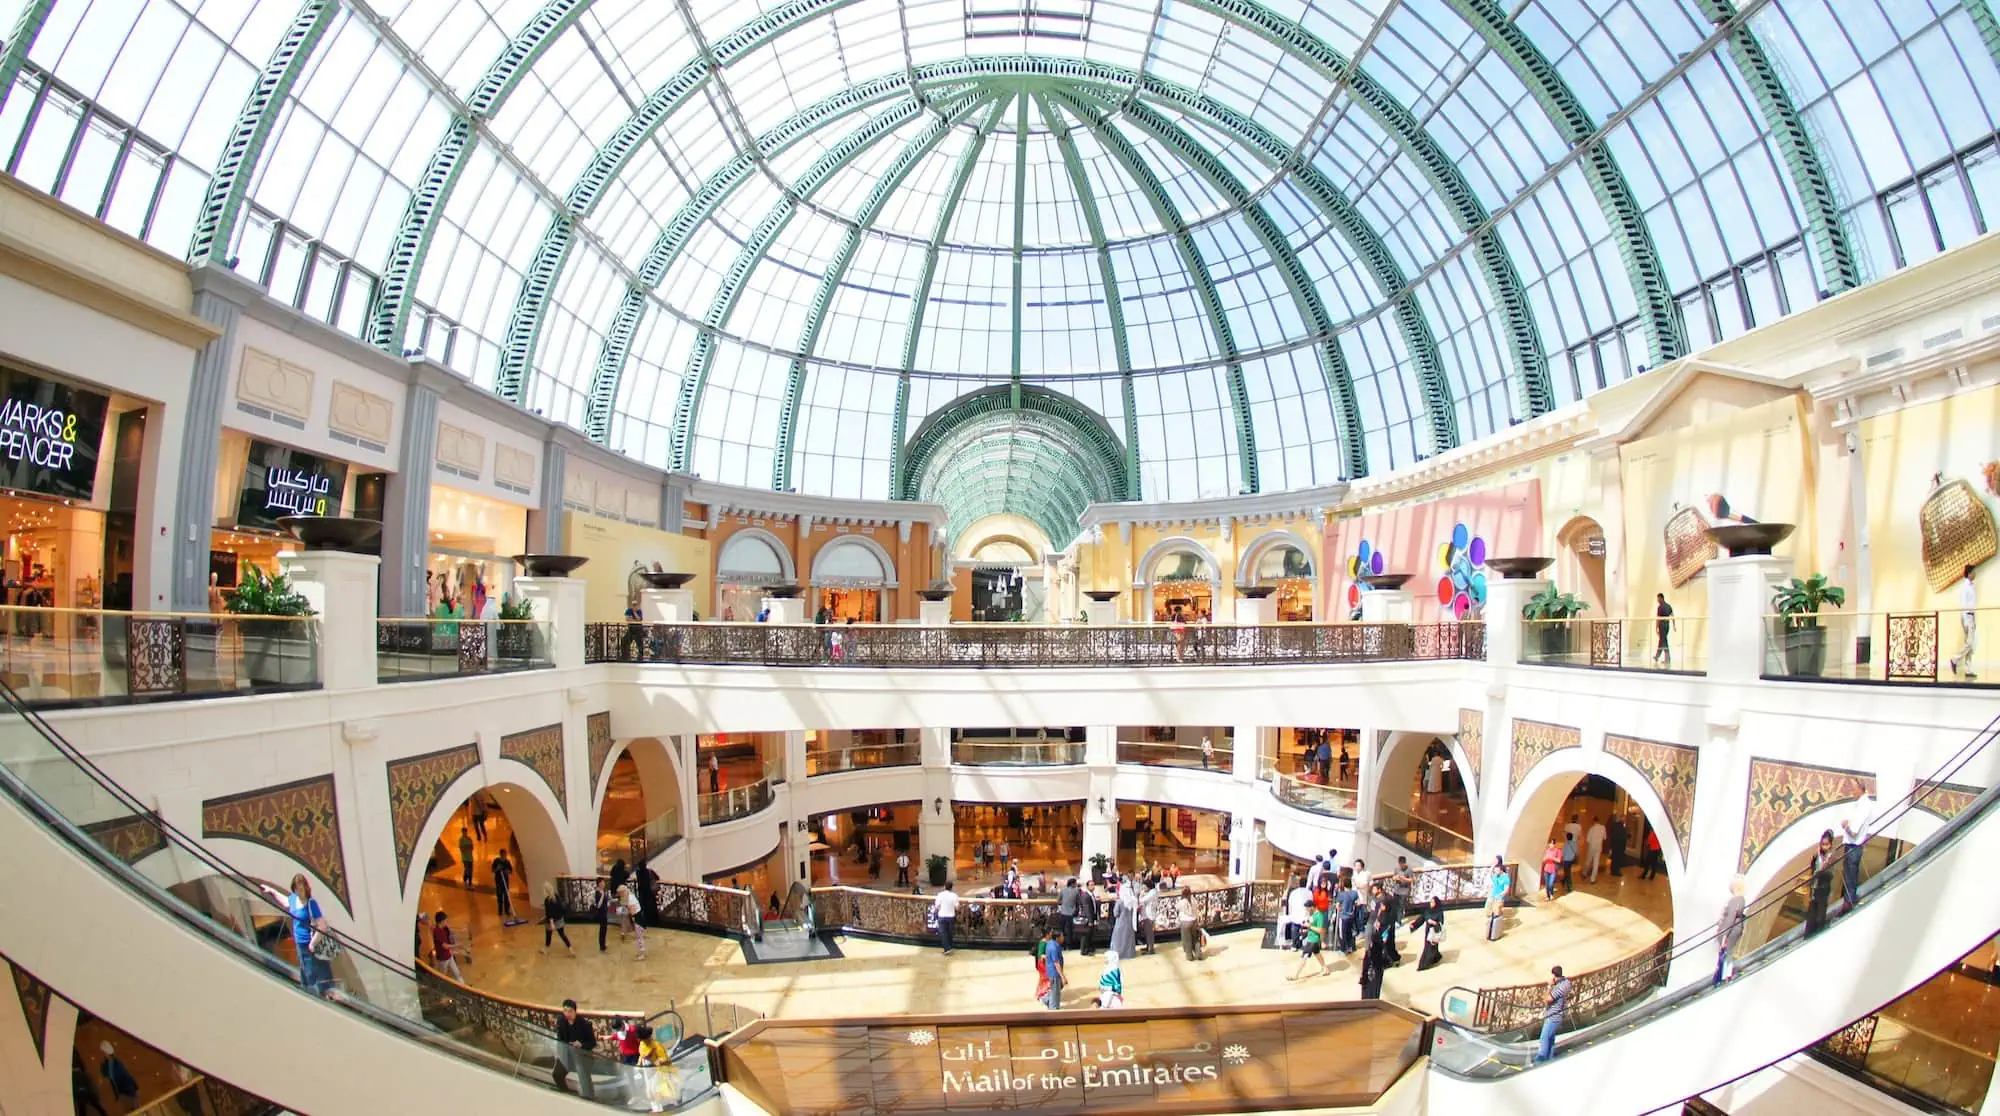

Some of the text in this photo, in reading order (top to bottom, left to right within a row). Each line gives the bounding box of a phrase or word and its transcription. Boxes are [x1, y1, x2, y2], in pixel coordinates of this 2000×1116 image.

[268, 466, 329, 494] ماركس
[1012, 1072, 1036, 1091] of
[1040, 1072, 1077, 1090] the
[1083, 1063, 1218, 1088] Emirates
